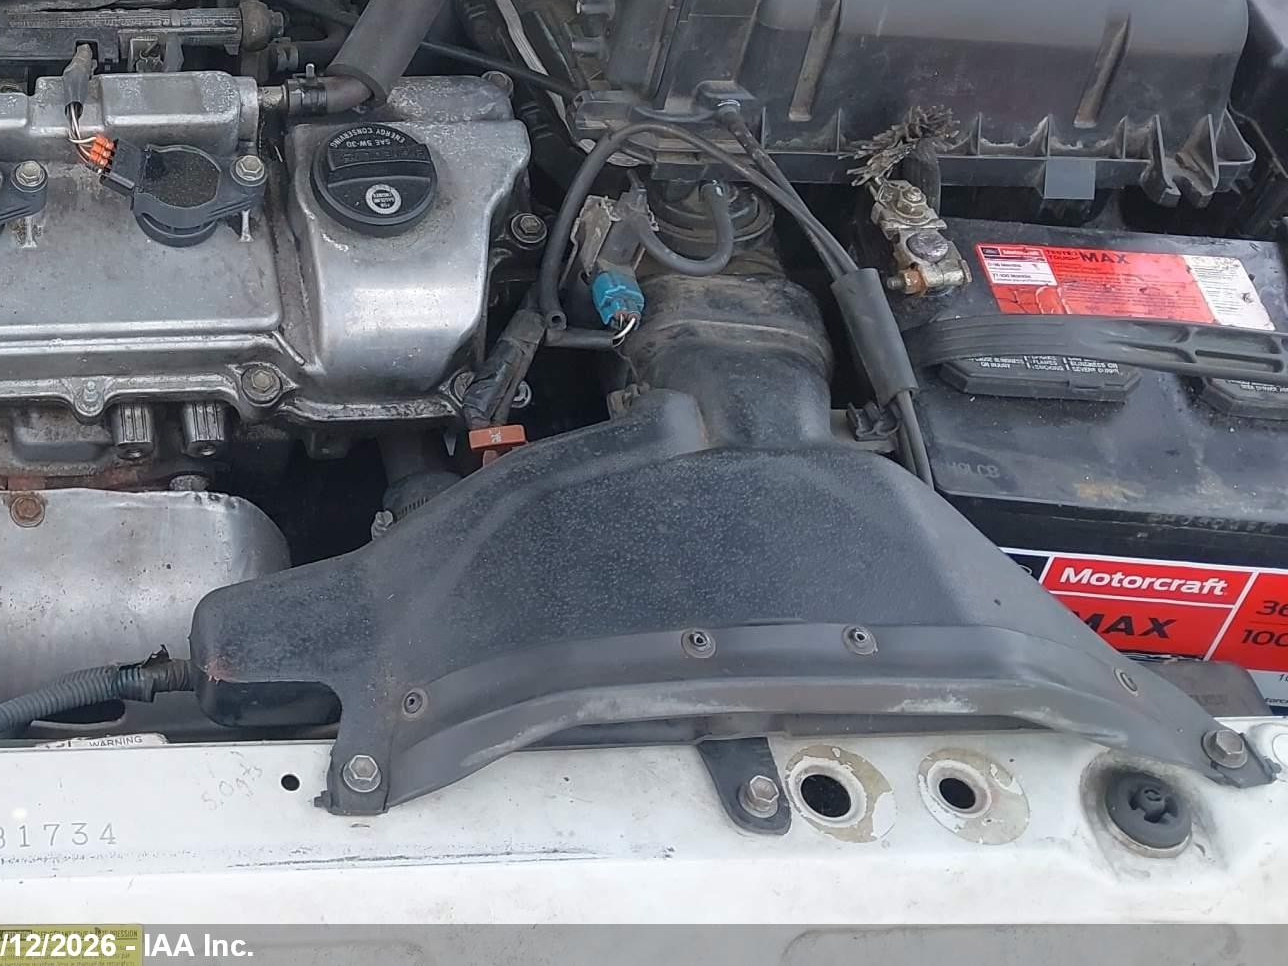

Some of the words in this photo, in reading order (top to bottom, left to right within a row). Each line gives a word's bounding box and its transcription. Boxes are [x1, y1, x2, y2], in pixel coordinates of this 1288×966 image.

[329, 127, 373, 148] CONSERVING
[345, 139, 373, 148] 5W-30
[374, 138, 391, 146] SAE
[375, 128, 406, 144] ENERGY
[1078, 249, 1130, 264] MAX
[1059, 566, 1230, 596] Motorcraft
[88, 734, 144, 747] WARNING
